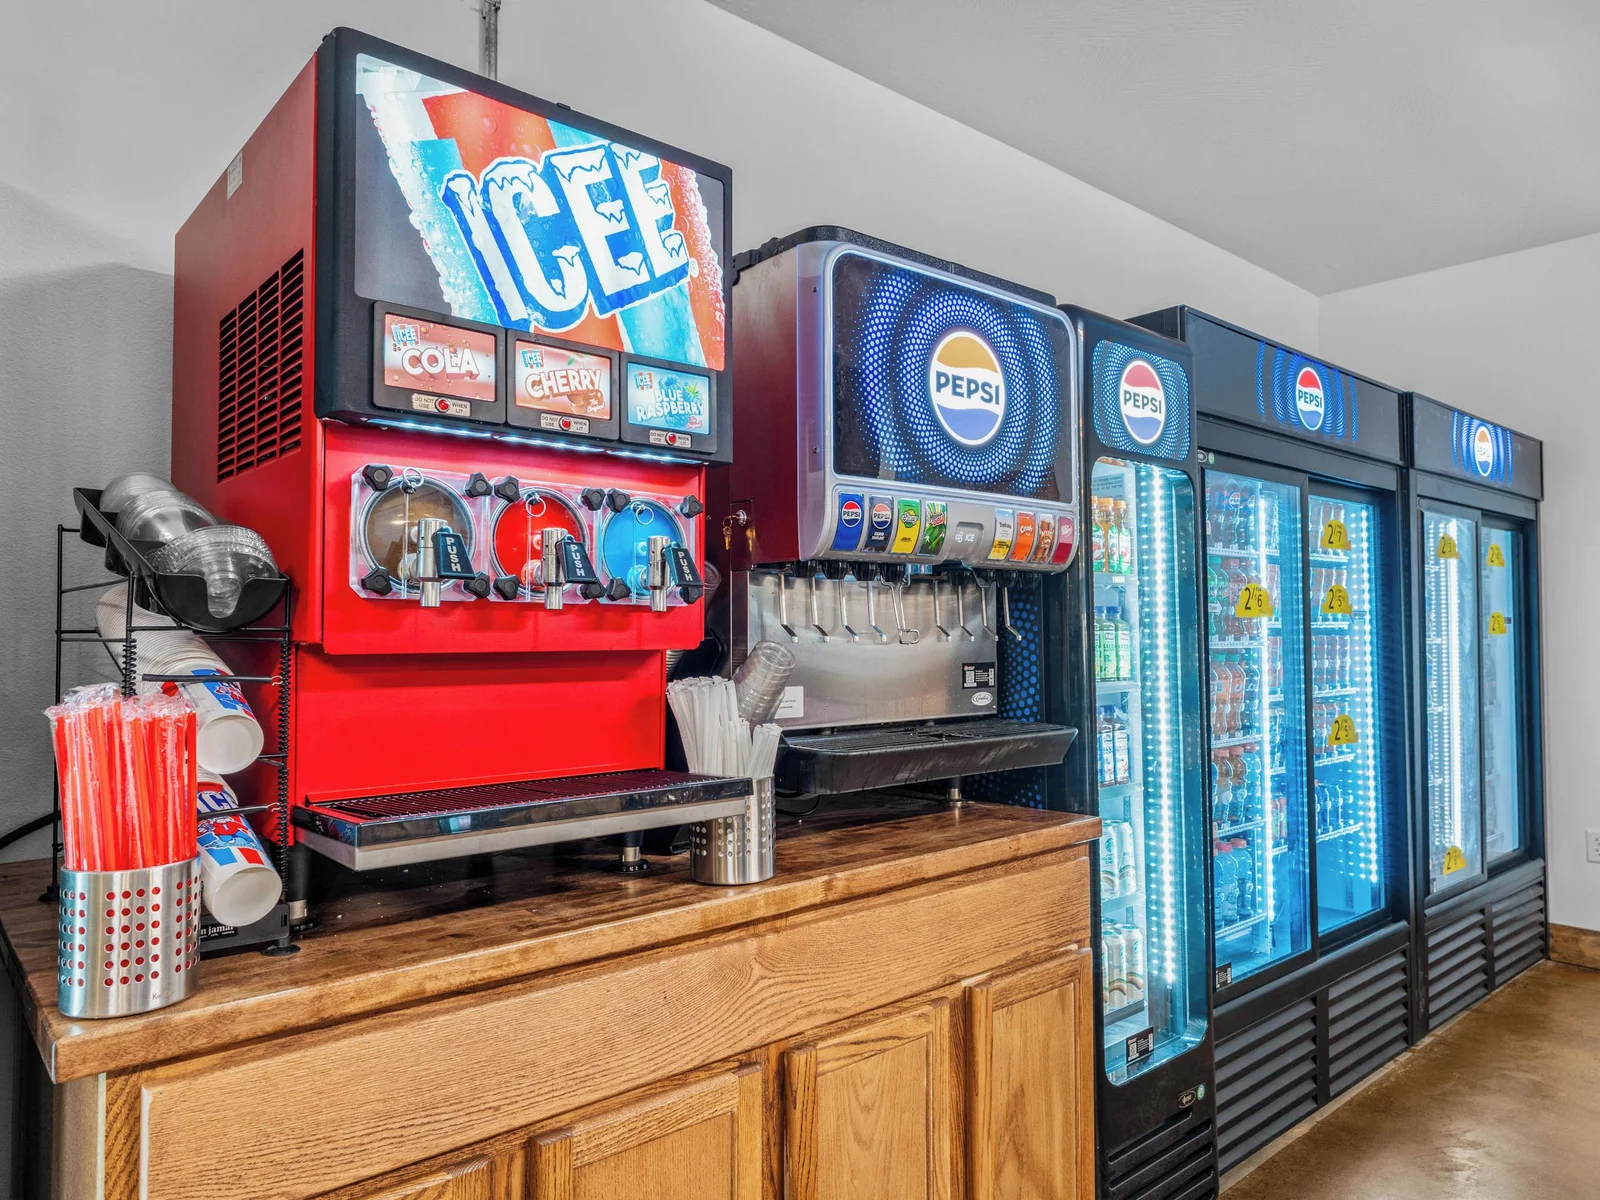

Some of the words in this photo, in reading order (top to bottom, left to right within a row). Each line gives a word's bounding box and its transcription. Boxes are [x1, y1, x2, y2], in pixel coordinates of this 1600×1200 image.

[439, 141, 690, 332] ICEE
[393, 325, 417, 344] ICEE
[402, 347, 480, 379] COLA
[525, 368, 602, 400] CHERRY
[654, 388, 684, 403] BLUE
[935, 370, 1000, 405] PEPSI
[635, 399, 704, 423] RASPBERRY
[1123, 389, 1162, 414] PEPSI
[1298, 389, 1322, 408] PEPSI
[843, 510, 861, 518] PEPSI
[964, 533, 975, 542] ICE
[445, 536, 462, 572] PUSH
[570, 544, 586, 577] PUSH
[677, 551, 693, 582] PUSH
